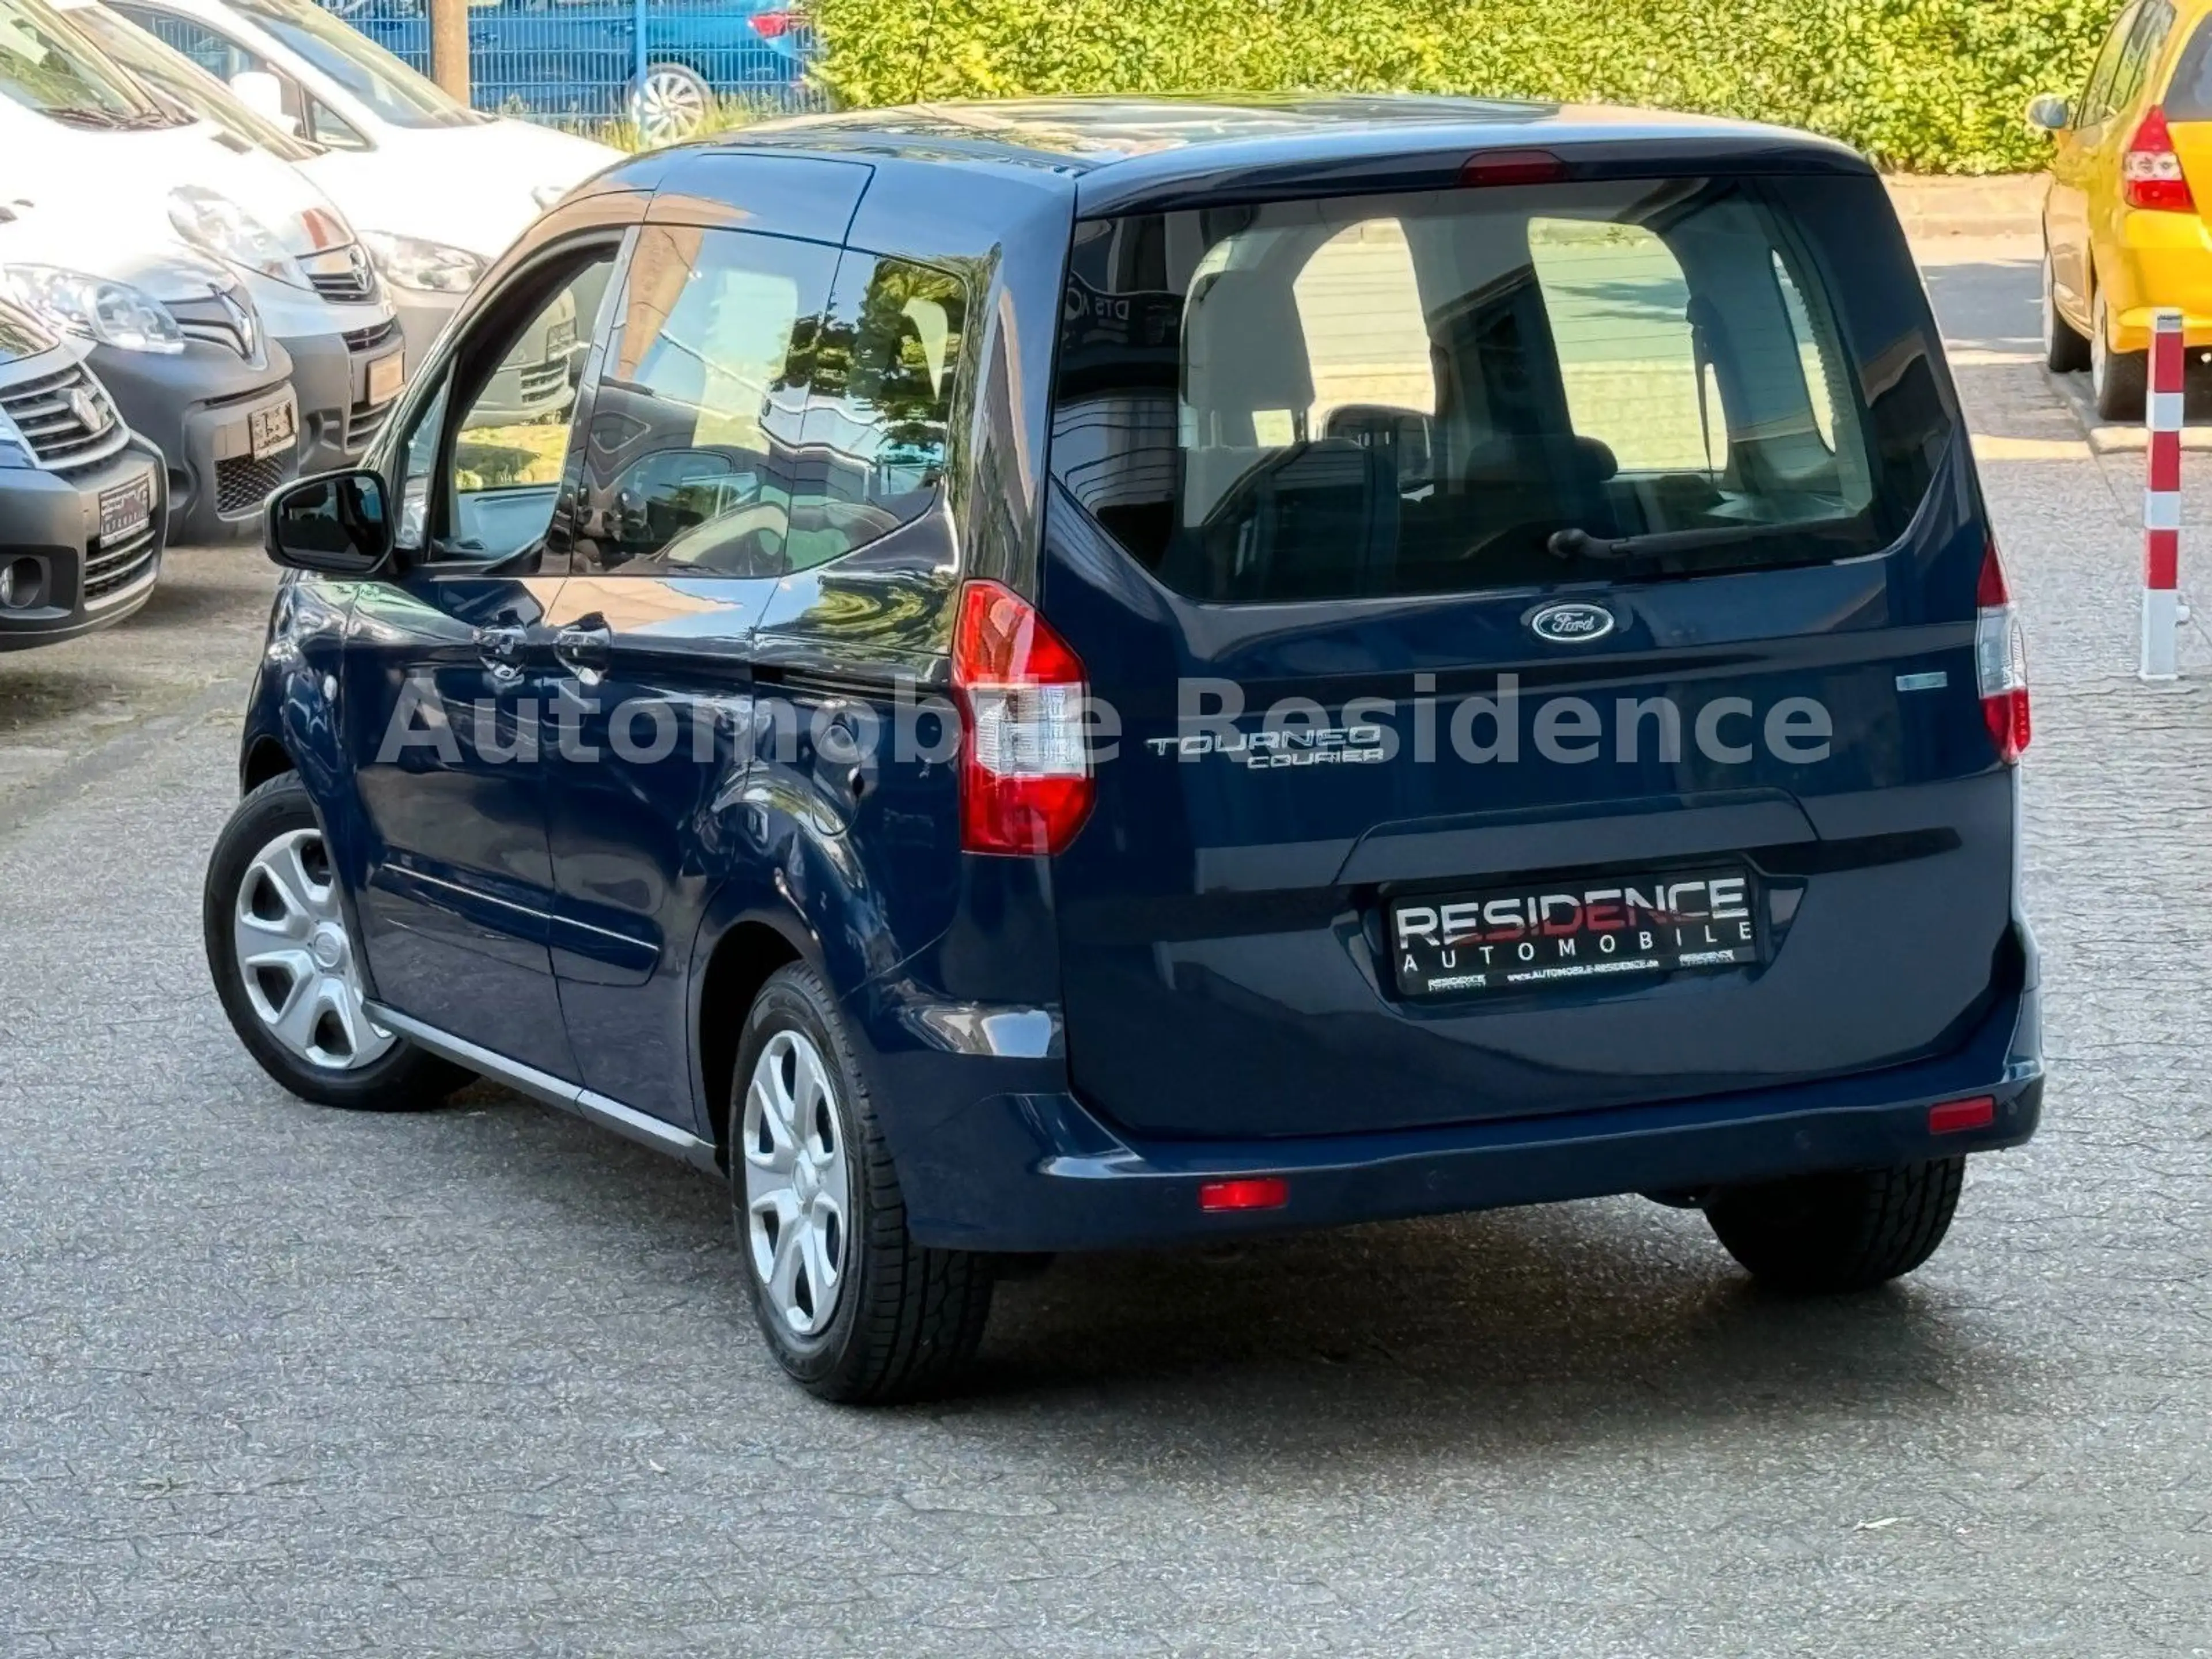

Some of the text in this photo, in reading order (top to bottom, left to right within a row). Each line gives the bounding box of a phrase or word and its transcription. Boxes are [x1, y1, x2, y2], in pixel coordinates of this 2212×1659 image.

[1552, 612, 1594, 632] Ford
[1145, 726, 1381, 755] TOURNEO
[1248, 749, 1383, 769] COURIER
[1396, 877, 1749, 949] RESIDENCE
[1403, 922, 1752, 974] AUTOMOBILE
